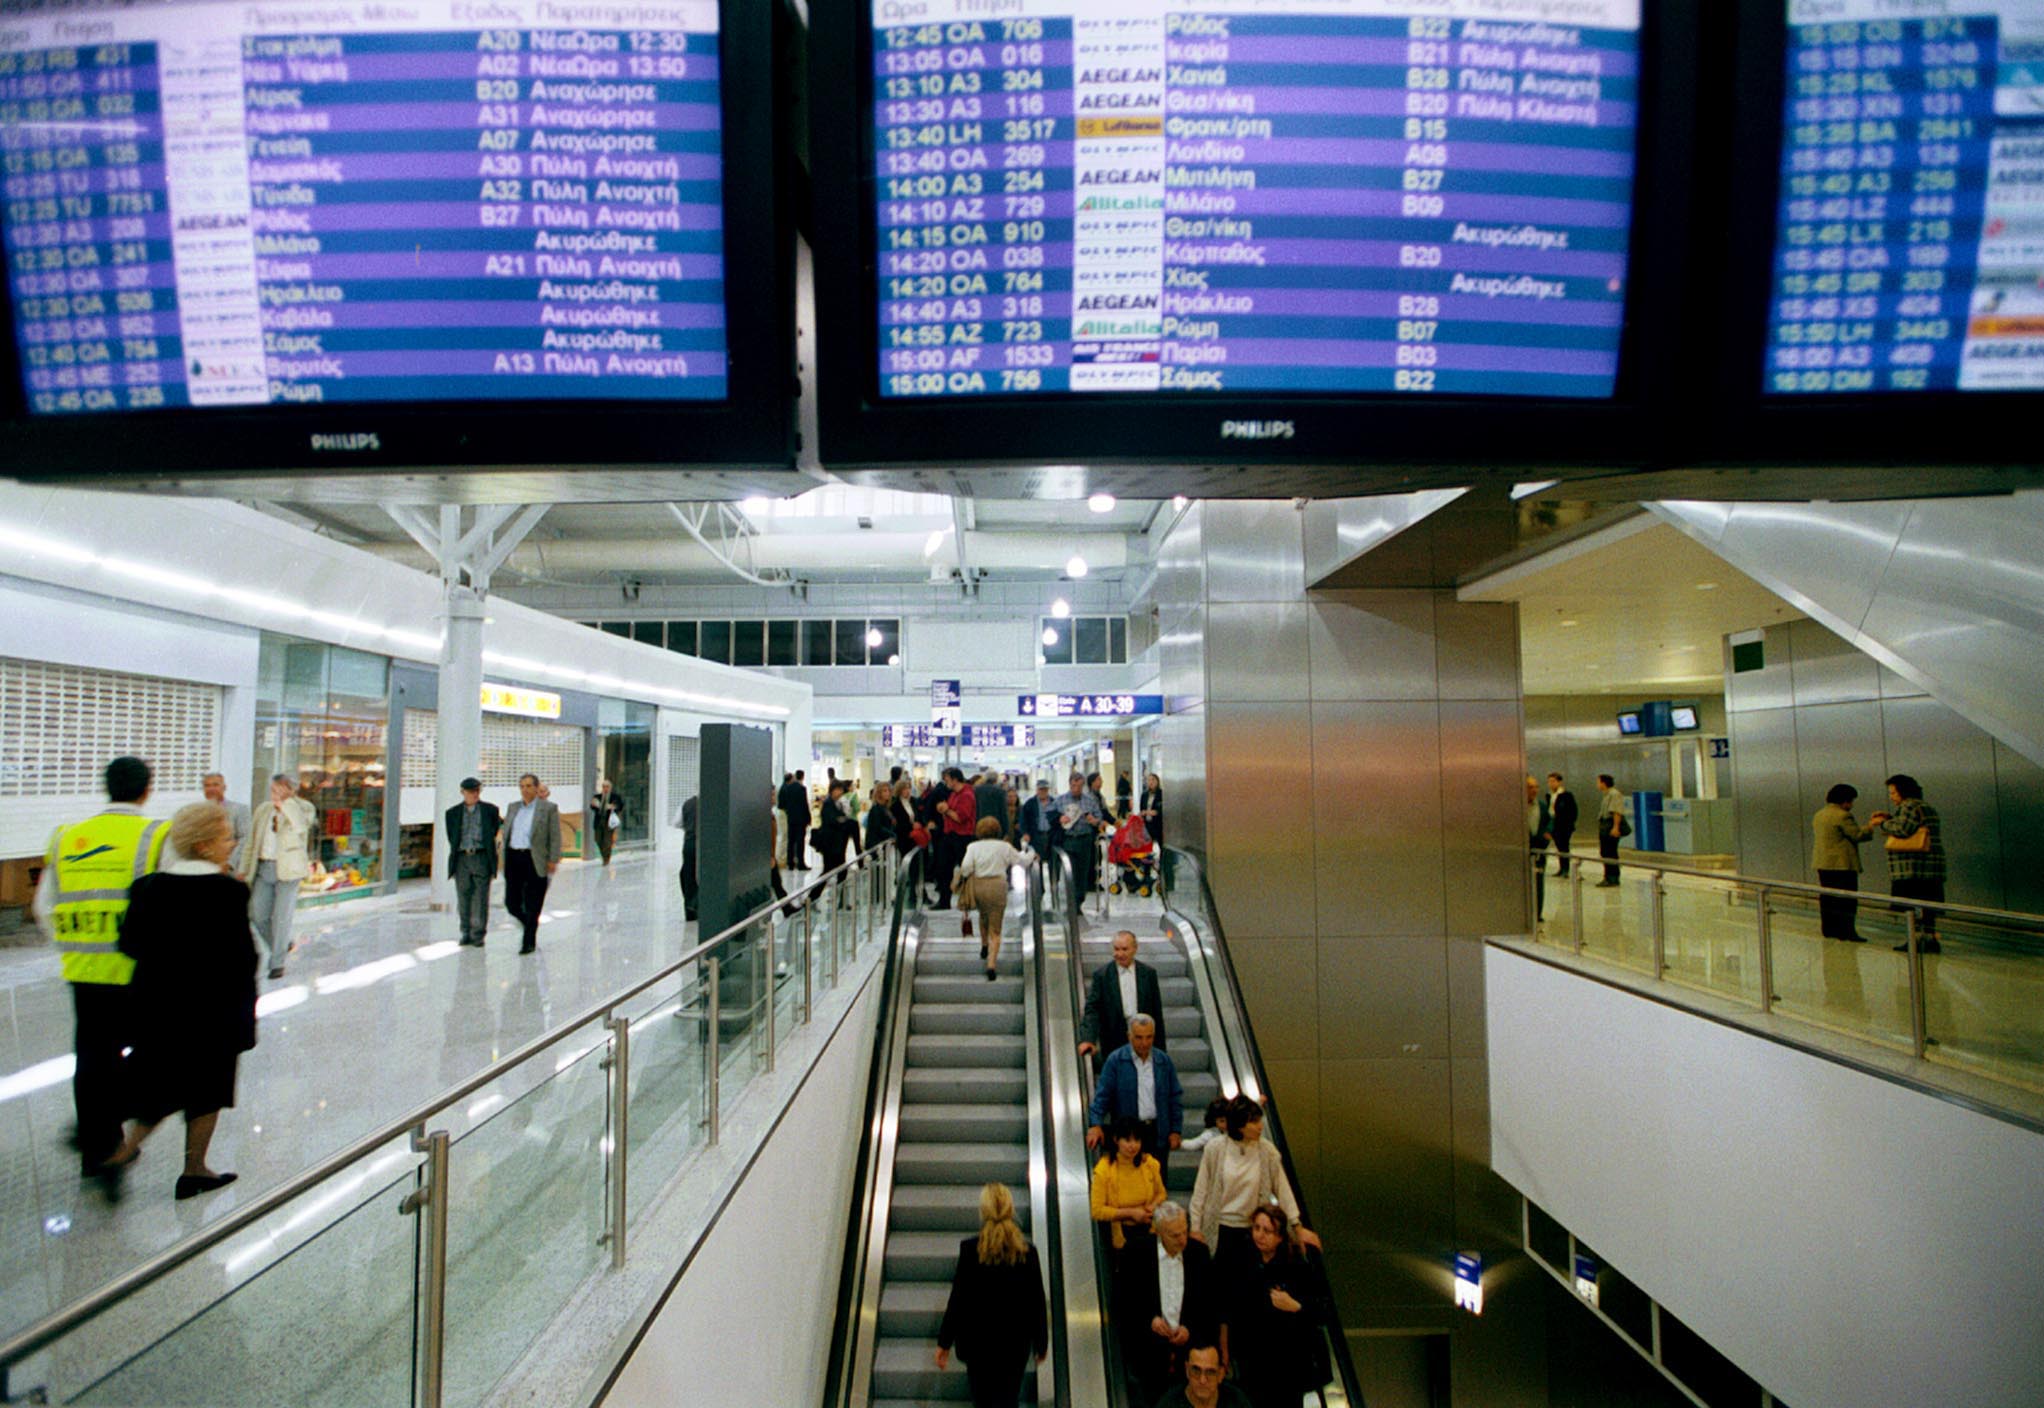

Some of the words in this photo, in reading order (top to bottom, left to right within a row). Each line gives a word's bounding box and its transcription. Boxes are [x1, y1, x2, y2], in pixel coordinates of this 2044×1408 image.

[629, 32, 687, 51] 12:30
[885, 25, 942, 48] 12:45
[947, 22, 985, 43] OA
[629, 57, 687, 77] 13:50
[885, 49, 943, 73] 13:05
[947, 46, 986, 69] OA
[1408, 41, 1449, 64] B21
[530, 81, 657, 103] Αναχώρησε
[885, 75, 944, 98] 13:10
[949, 72, 982, 94] A3
[1002, 69, 1044, 91] 304
[1079, 67, 1162, 85] AEGEAN
[1167, 65, 1228, 88] Χανιά
[1459, 70, 1515, 96] Πύλη
[478, 106, 519, 126] A31
[530, 106, 657, 128] Αναχώρησε
[886, 100, 945, 123] 13:30
[949, 97, 983, 118] A3
[1079, 93, 1162, 110] AEGEAN
[1457, 97, 1514, 122] Πύλη
[478, 131, 519, 151] A07
[530, 131, 657, 154] Αναχώρησε
[886, 125, 946, 148] 13:40
[949, 122, 983, 144] LH
[1003, 119, 1056, 142] 3517
[1405, 118, 1448, 140] B15
[480, 155, 522, 176] A30
[531, 156, 586, 178] Πύλη
[595, 157, 679, 180] Ανοιχτή
[886, 150, 947, 174] 13:40
[950, 147, 989, 168] OA
[1004, 144, 1047, 167] 269
[1167, 140, 1246, 164] Λονδίνο
[480, 180, 522, 200] A32
[531, 181, 587, 203] Πύλη
[595, 182, 680, 205] Ανοιχτή
[887, 175, 947, 198] 14:00
[951, 172, 985, 194] A3
[1004, 169, 1046, 192] 254
[1079, 168, 1162, 187] AEGEAN
[1166, 165, 1256, 190] Μυτιλήνη
[1403, 167, 1444, 190] B27
[480, 206, 520, 227] B27
[533, 206, 589, 229] Πύλη
[596, 207, 680, 231] Ανοιχτή
[888, 202, 947, 223] 14:10
[951, 199, 986, 220] AZ
[1004, 195, 1046, 218] 729
[1078, 195, 1164, 211] Alitalia
[1165, 191, 1237, 213] Μιλάνο
[1402, 194, 1445, 217] B09
[535, 231, 658, 254] Ακυρώθηκε
[888, 226, 947, 249] 14:15
[950, 223, 989, 245] OA
[1003, 220, 1046, 242] 910
[1165, 216, 1253, 241] Θεσ/νίκη
[1452, 223, 1569, 250] Ακυρώθηκε
[485, 256, 525, 276] A21
[536, 256, 592, 279] Πύλη
[599, 256, 682, 280] Ανοιχτή
[888, 251, 947, 275] 14:20
[950, 248, 989, 270] OA
[1165, 242, 1267, 267] Κάρπαθος
[1400, 244, 1442, 268] B20
[538, 281, 660, 304] Ακυρώθηκε
[888, 276, 947, 300] 14:20
[950, 273, 989, 295] OA
[1003, 271, 1044, 293] 764
[1165, 267, 1209, 291] Χίος
[1450, 273, 1566, 299] Ακυρώθηκε
[540, 306, 662, 328] Ακυρώθηκε
[888, 301, 947, 323] 14:40
[950, 298, 983, 320] A3
[1003, 296, 1044, 318] 318
[1078, 295, 1158, 311] AEGEAN
[1164, 292, 1254, 315] Ηράκλειο
[543, 330, 664, 353] Ακυρώθηκε
[888, 325, 946, 347] 14:55
[950, 322, 985, 343] AZ
[1002, 320, 1043, 343] 723
[1076, 320, 1161, 336] Alitalia
[1162, 316, 1220, 341] Ρώμη
[1397, 320, 1439, 342] B07
[494, 354, 535, 374] A13
[544, 354, 599, 377] Πύλη
[606, 354, 688, 378] Ανοιχτή
[888, 349, 946, 372] 15:00
[950, 347, 982, 368] AF
[1004, 344, 1055, 366] 1533
[1396, 344, 1438, 367] B03
[888, 374, 946, 397] 15:00
[948, 371, 987, 392] OA
[1160, 365, 1224, 390] Σάμος
[1394, 369, 1436, 391] B22
[310, 433, 380, 449] PHILIPS
[1221, 420, 1295, 438] PHILIPS
[1080, 696, 1094, 713] A
[1094, 695, 1135, 714] 30-39
